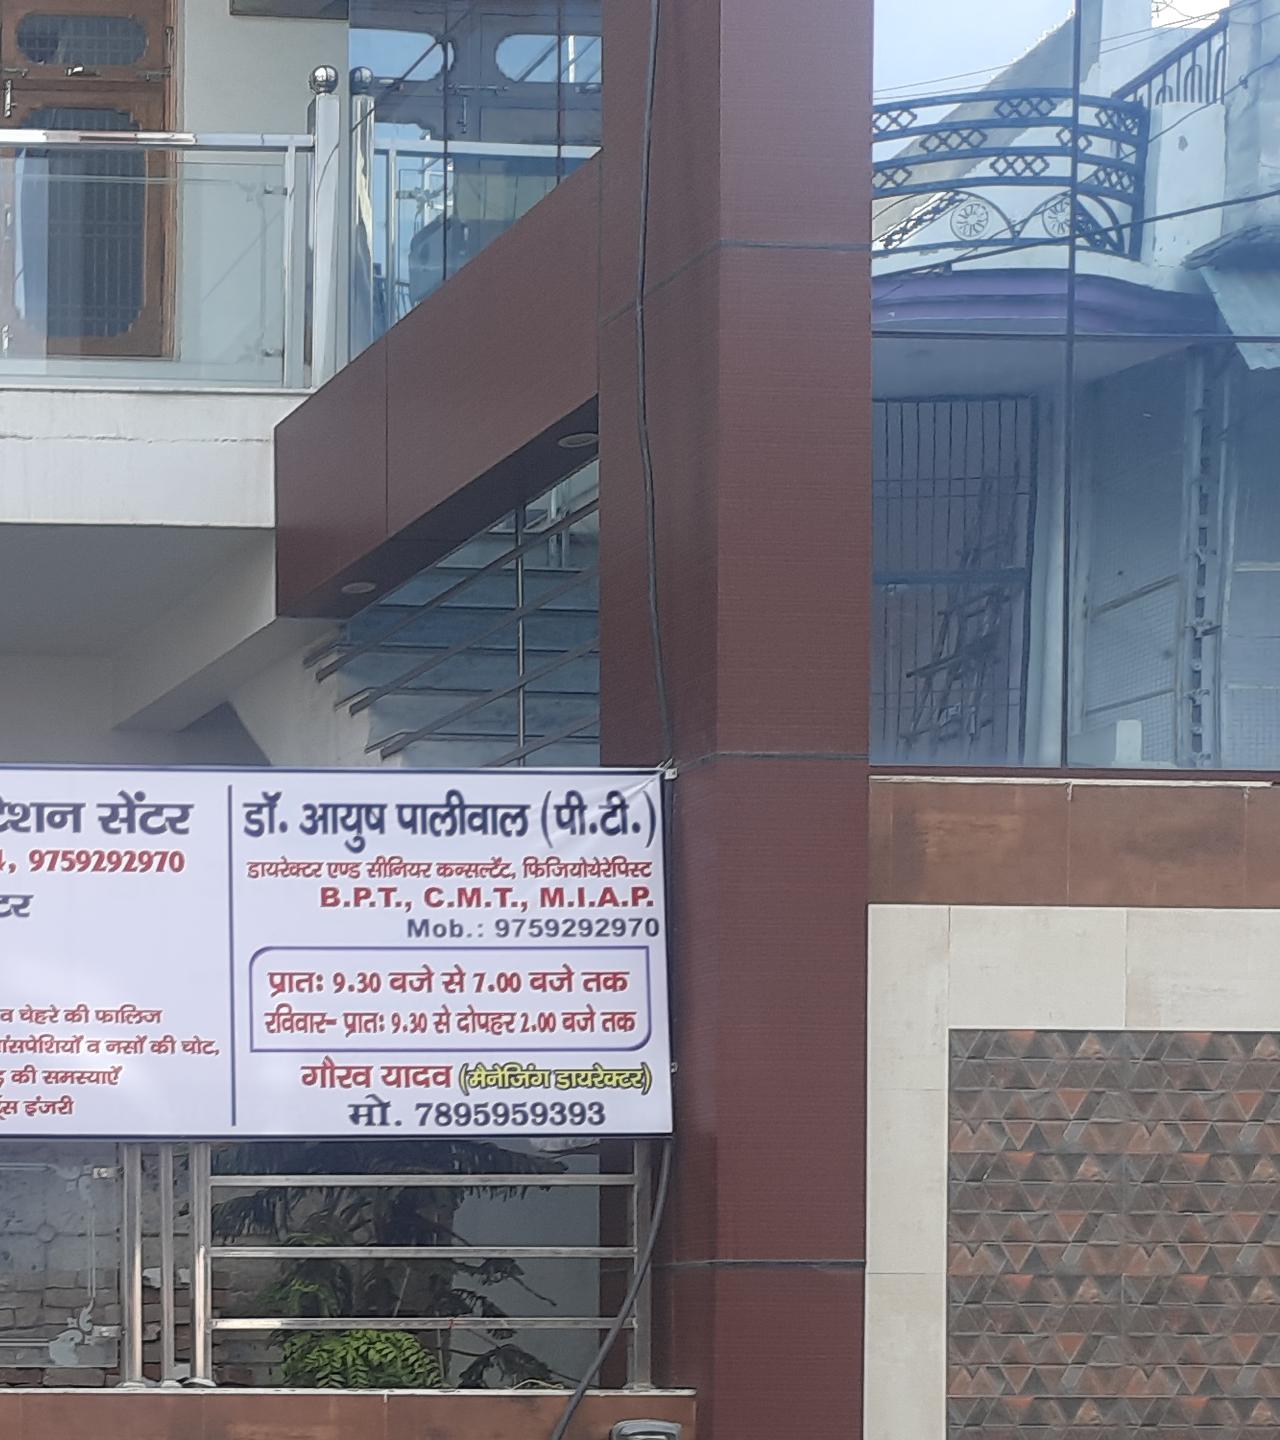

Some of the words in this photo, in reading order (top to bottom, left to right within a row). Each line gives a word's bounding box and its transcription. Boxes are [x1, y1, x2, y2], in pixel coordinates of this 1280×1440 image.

[97, 789, 194, 836] सेंटर
[243, 792, 288, 836] डॉ.
[299, 803, 386, 852] आयुष
[397, 790, 530, 838] पालीवाल
[541, 789, 657, 848] (पी.टी.)
[29, 849, 186, 874] 9759292970
[247, 857, 322, 880] डायरेक्टर
[327, 861, 361, 880] एण्ड
[367, 855, 431, 880] सीनियर
[320, 886, 413, 913] B.P.T.,
[424, 887, 528, 914] C.M.T.,
[541, 887, 654, 909] M.I.A.P.
[495, 918, 661, 940] 9759292970
[333, 972, 381, 994] 9.30
[441, 965, 465, 993] से
[472, 973, 521, 994] 7.00
[581, 971, 630, 994] तक
[0, 1009, 14, 1023] व
[19, 1004, 60, 1025] चेहरे
[64, 1004, 90, 1023] की
[95, 1004, 163, 1025] फालिज
[392, 1011, 428, 1033] 9.30
[434, 1005, 450, 1033] से
[456, 1005, 514, 1035] दोपहर
[520, 1012, 556, 1033] 2.00
[601, 1011, 636, 1034] तक
[87, 1039, 100, 1054] व
[106, 1035, 147, 1054] नसों
[150, 1035, 177, 1055] की
[181, 1035, 220, 1056] चोट,
[11, 1065, 38, 1084] की
[301, 1056, 372, 1089] गौरव
[381, 1065, 452, 1089] यादव
[555, 1063, 652, 1095] डायरेक्टर)
[25, 1096, 74, 1117] इंजरी
[349, 1095, 402, 1127] मो.
[415, 1101, 606, 1127] 7895959393
